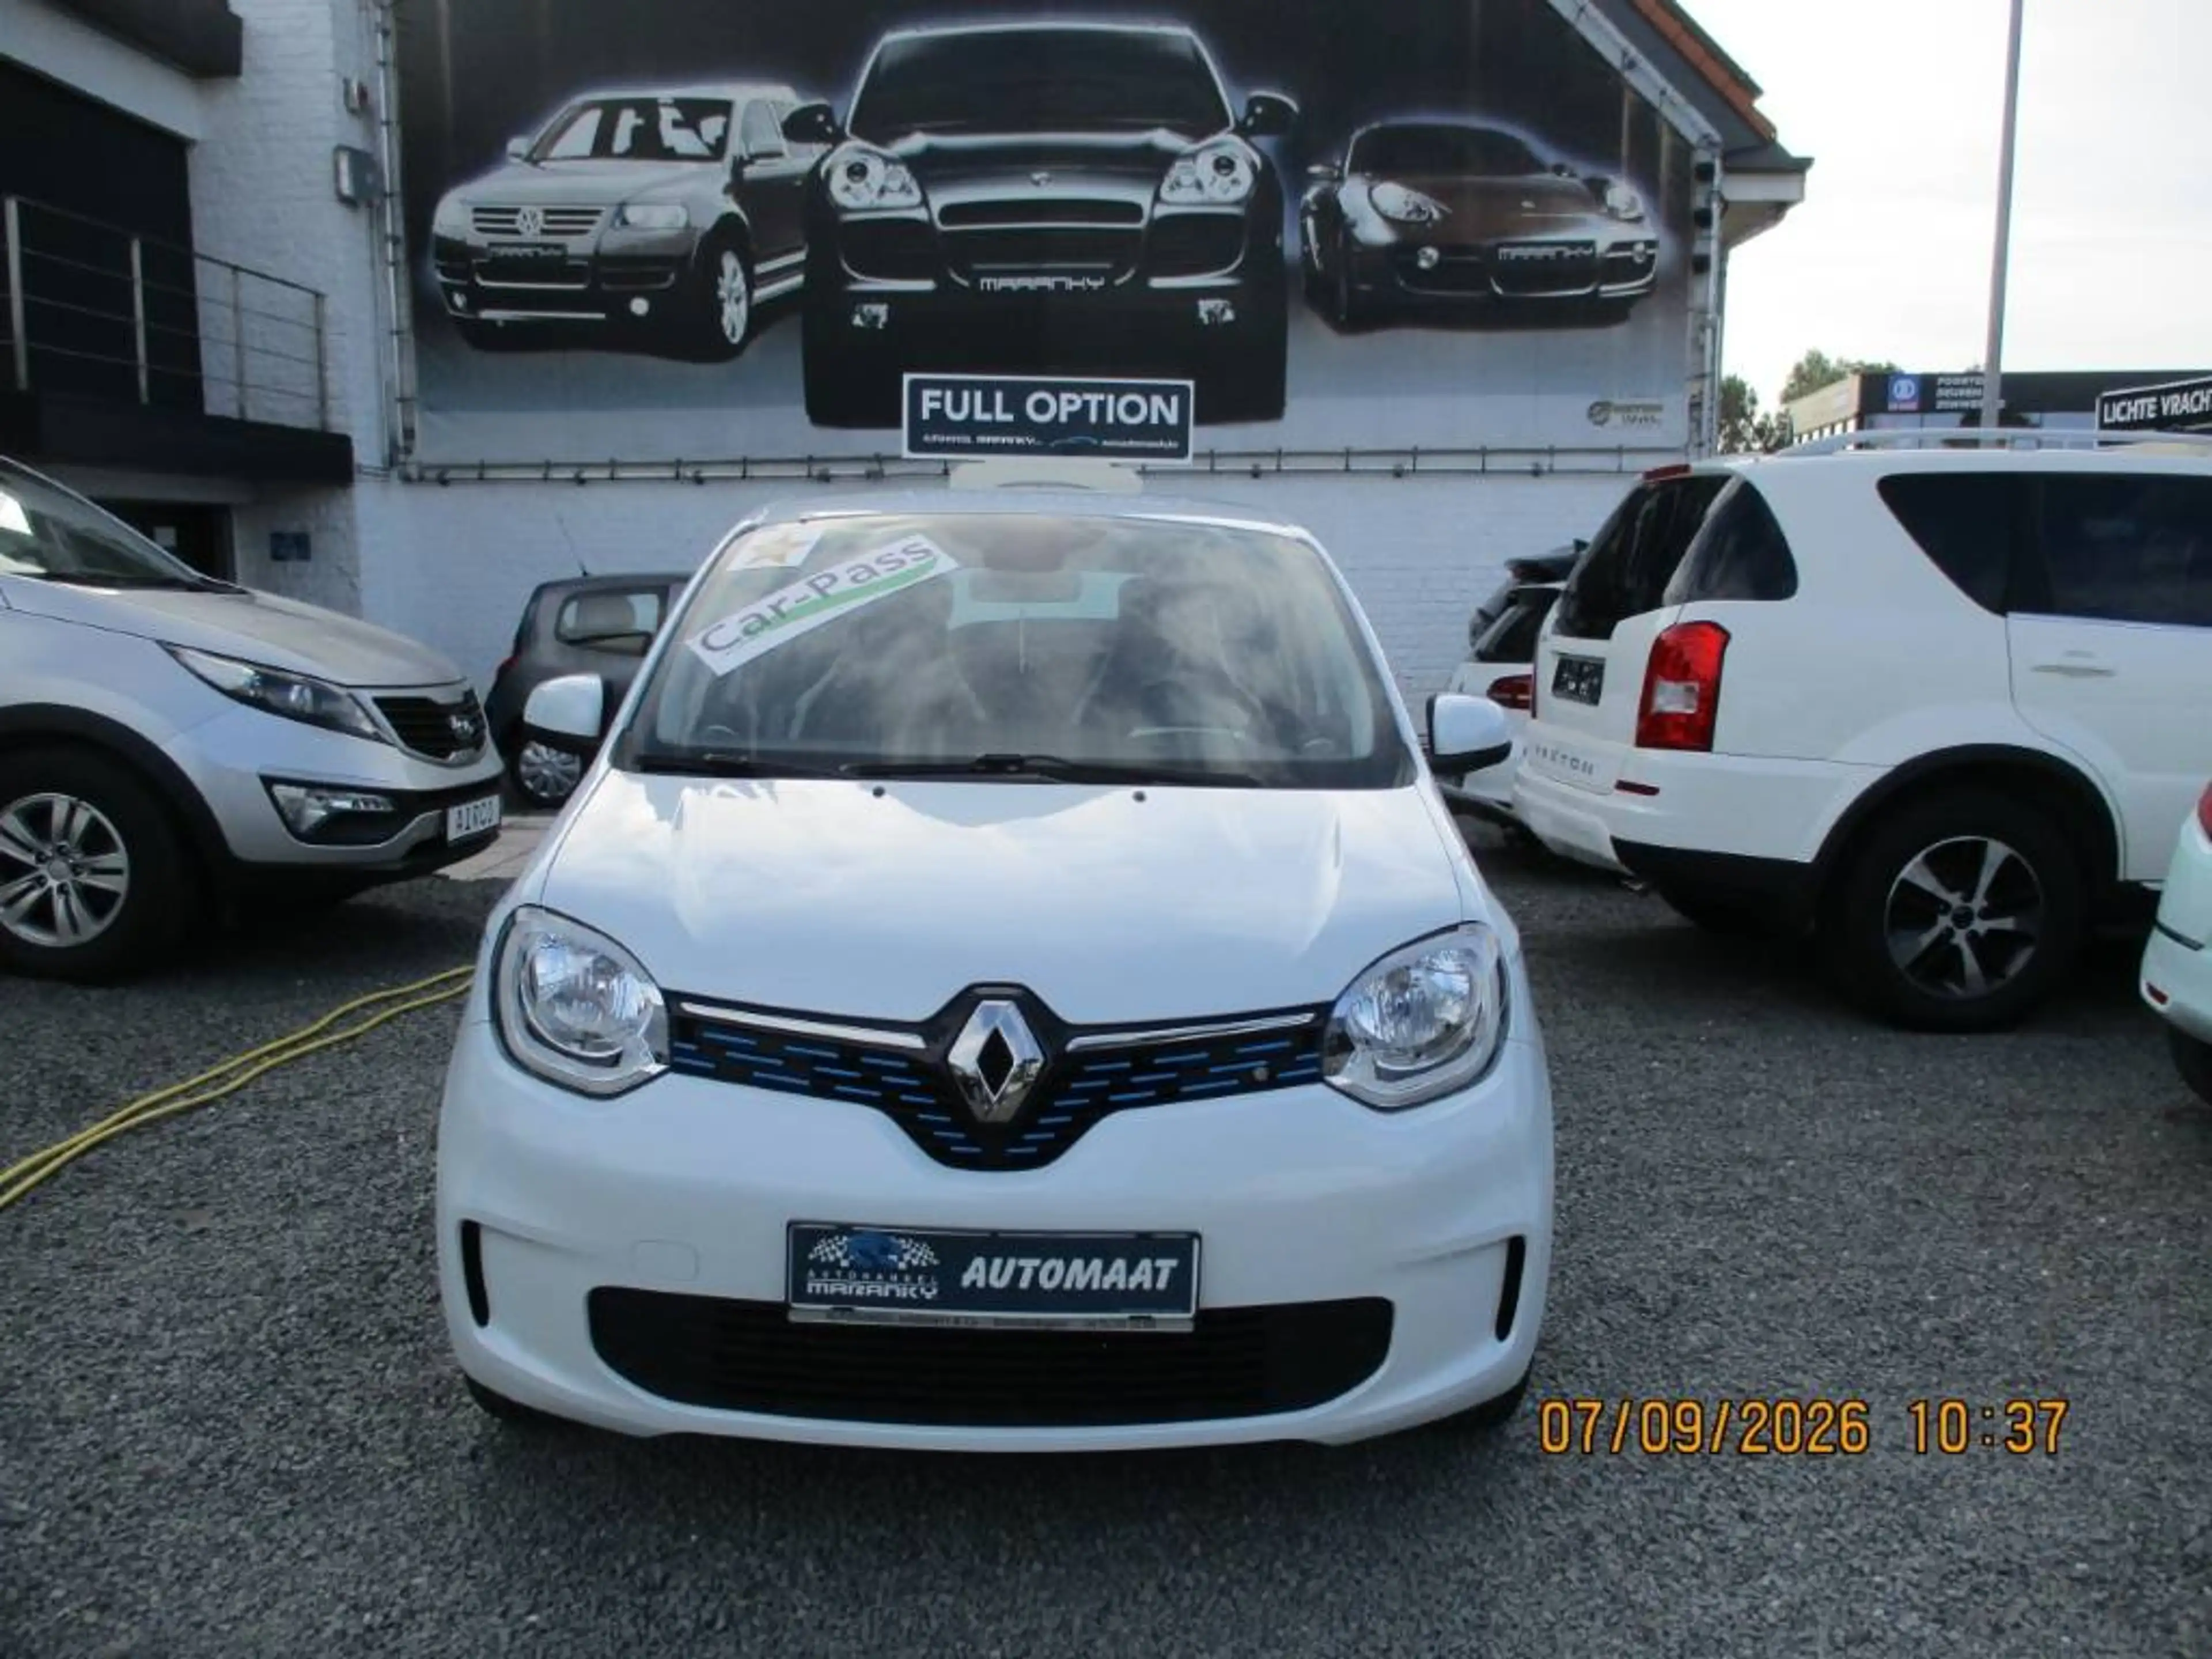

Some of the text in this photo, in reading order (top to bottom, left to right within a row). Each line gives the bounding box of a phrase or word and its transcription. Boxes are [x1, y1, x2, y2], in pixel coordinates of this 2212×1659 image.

[921, 389, 1180, 425] FULL OPTION
[2103, 397, 2158, 424] LICHTE
[700, 539, 935, 653] Car-Pass
[960, 1256, 1179, 1291] AUTOMAAT
